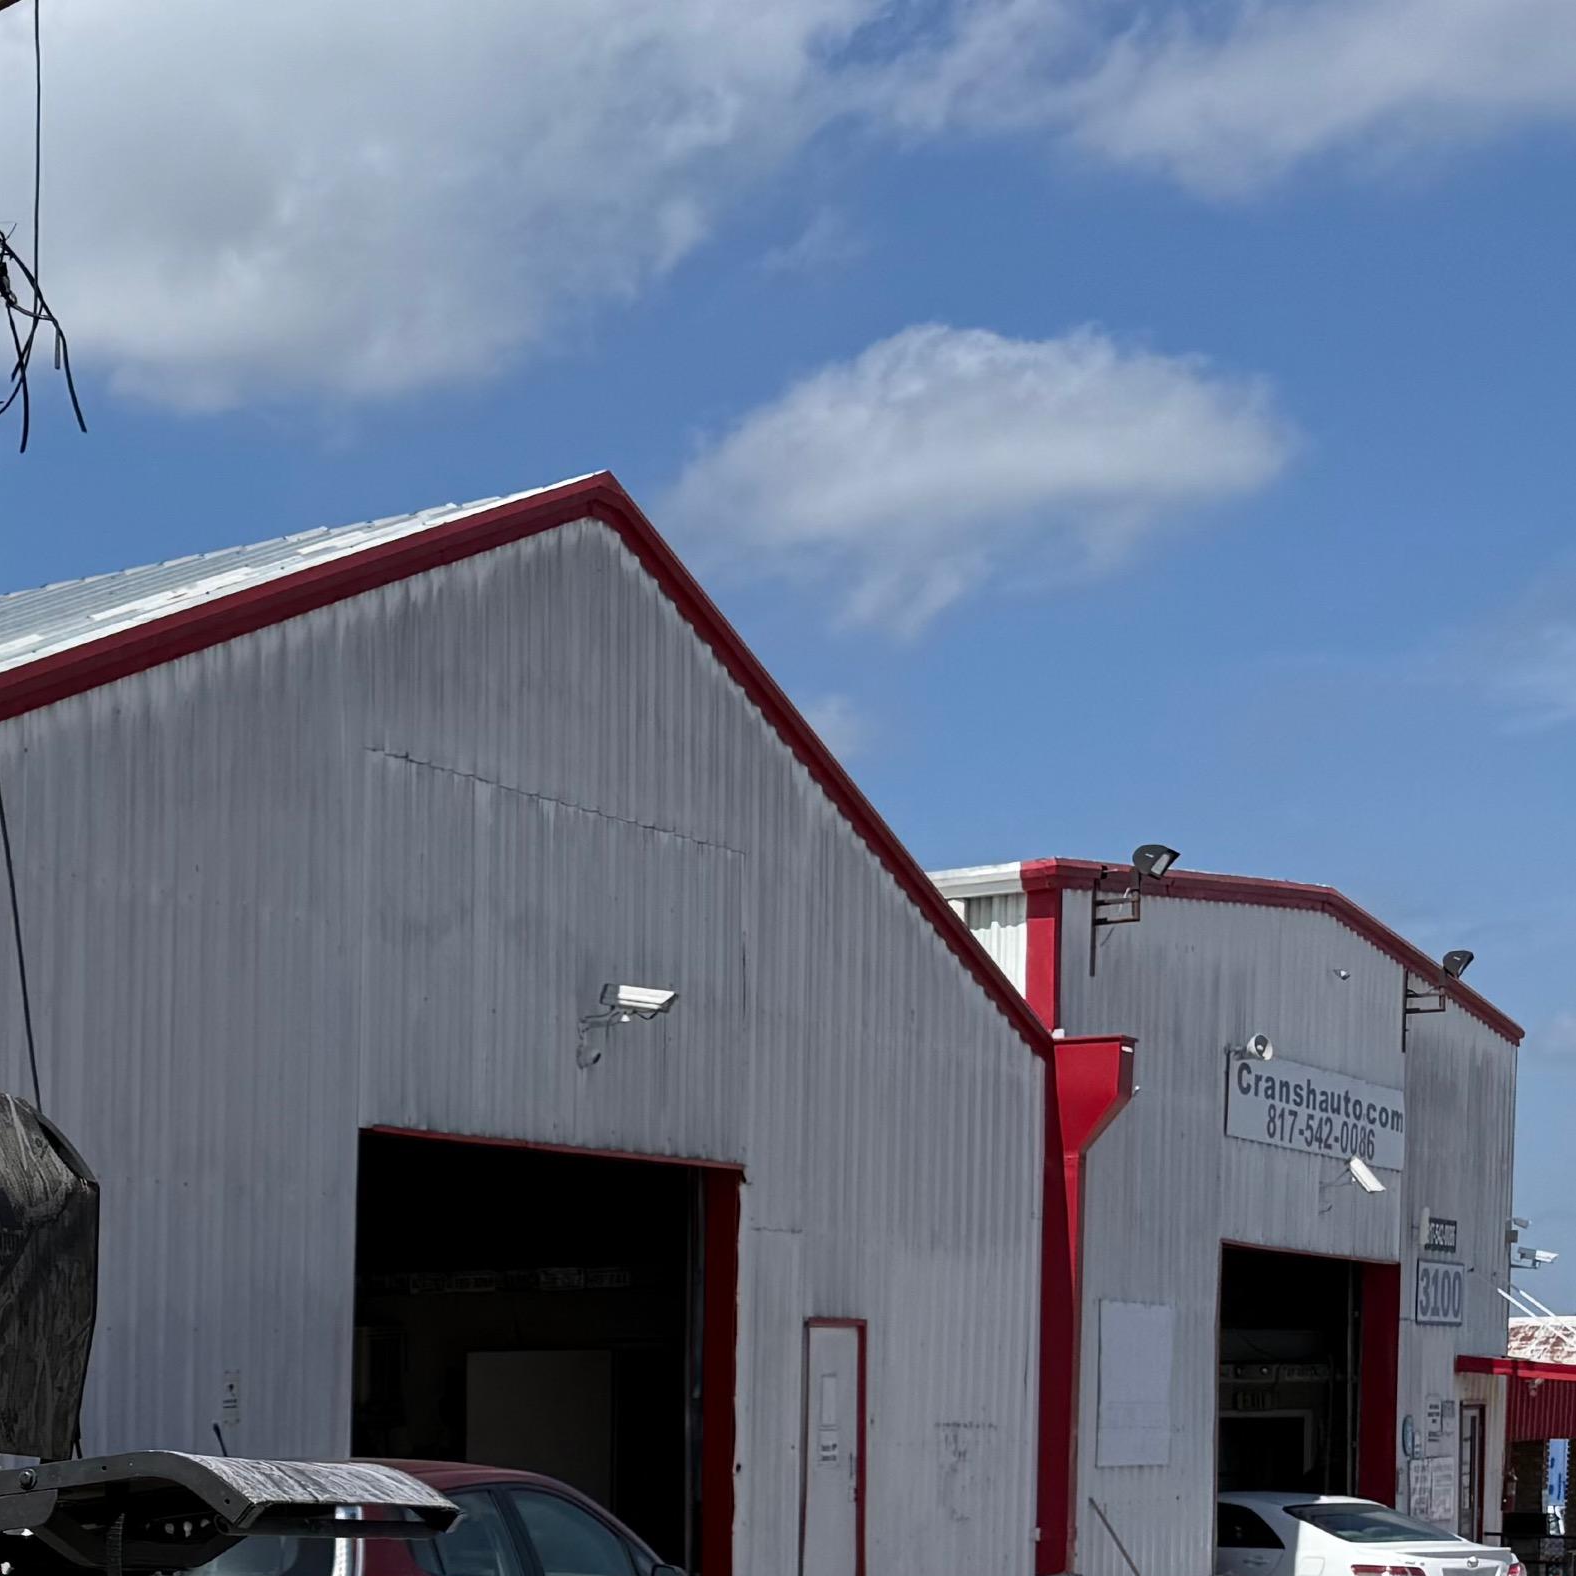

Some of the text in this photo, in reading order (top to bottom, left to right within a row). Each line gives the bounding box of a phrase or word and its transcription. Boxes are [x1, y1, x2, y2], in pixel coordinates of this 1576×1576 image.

[1237, 1062, 1403, 1133] Cranshauto.com
[1267, 1103, 1376, 1161] 817-542-0086
[1419, 1267, 1462, 1319] 3100
